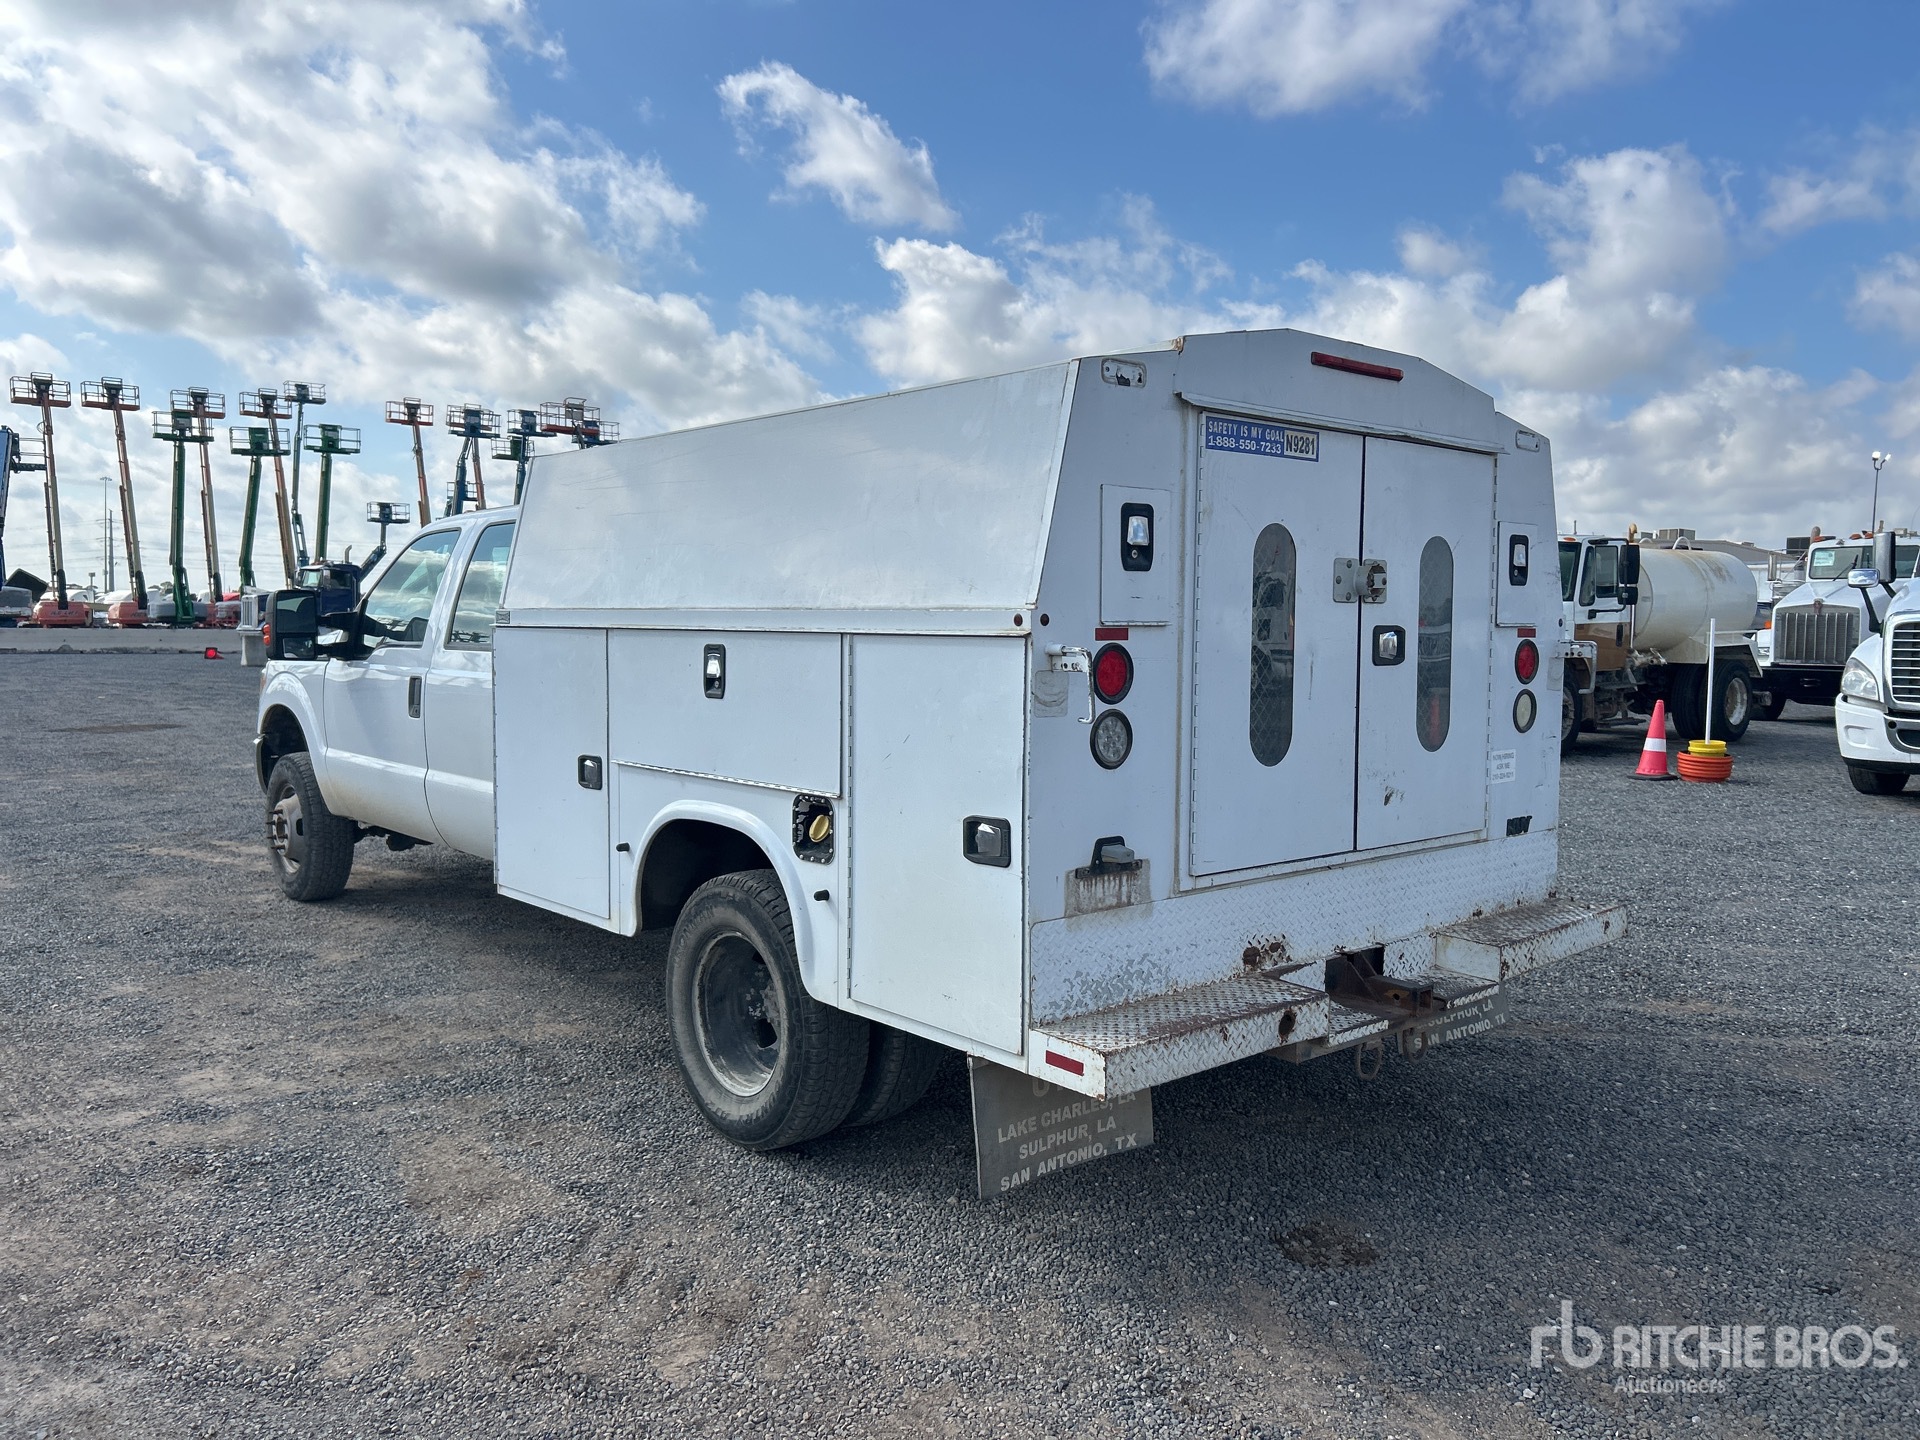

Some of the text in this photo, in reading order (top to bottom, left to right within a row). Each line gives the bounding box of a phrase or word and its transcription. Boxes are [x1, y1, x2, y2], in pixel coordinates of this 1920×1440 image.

[1208, 421, 1284, 442] SAFETY IS MY GOAL
[1208, 435, 1282, 454] 1-888-550-7233
[1285, 434, 1316, 455] N9281
[1482, 999, 1494, 1012] LA
[1494, 1012, 1506, 1025] TX
[997, 1116, 1037, 1143] LAKE
[1040, 1098, 1113, 1128] CHARLES,
[1018, 1116, 1117, 1160] SULPHUR, LA
[1000, 1132, 1137, 1192] SAN ANTONIO, TX
